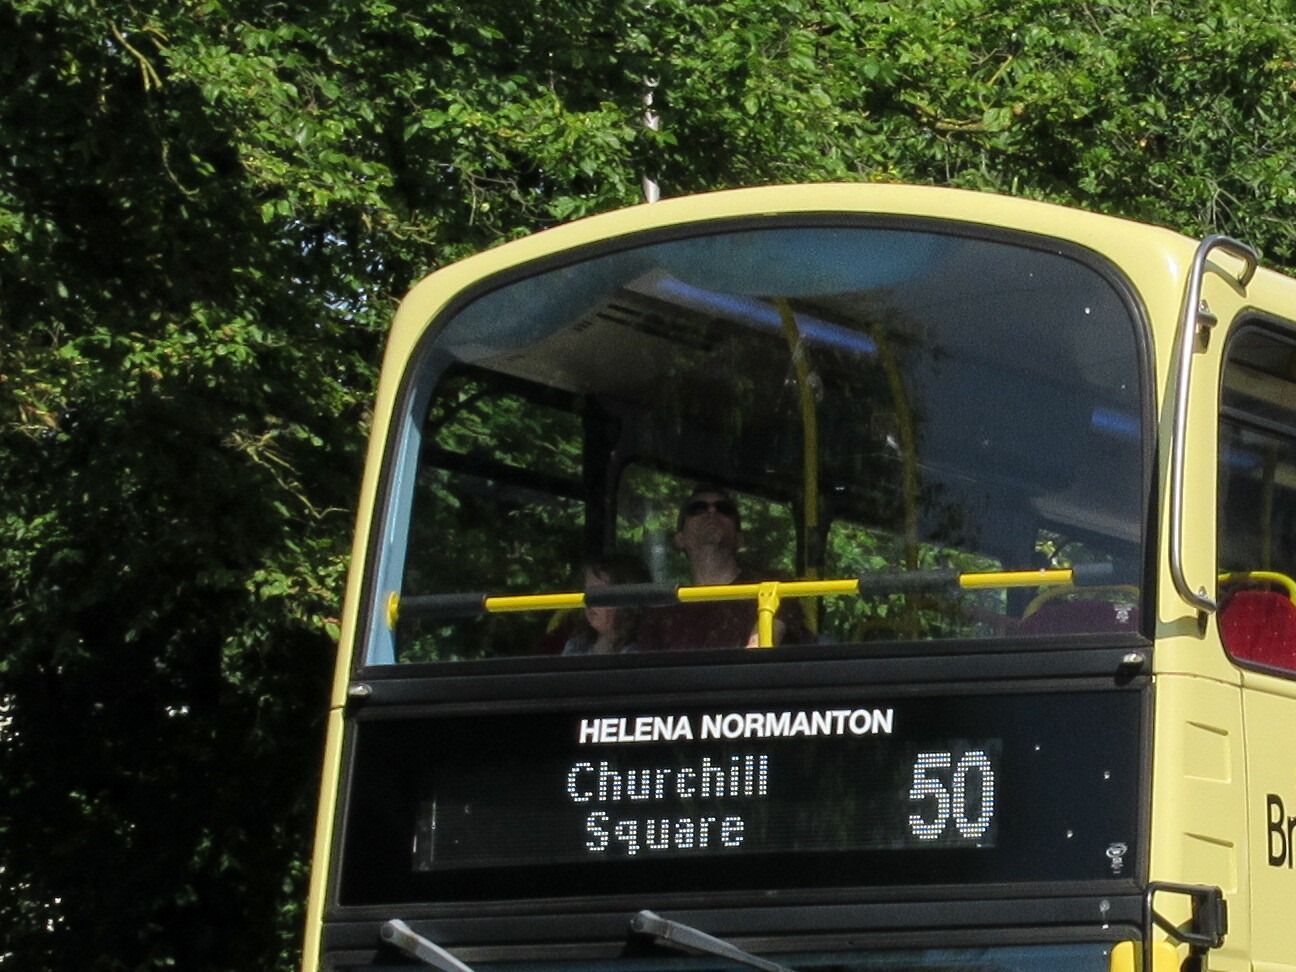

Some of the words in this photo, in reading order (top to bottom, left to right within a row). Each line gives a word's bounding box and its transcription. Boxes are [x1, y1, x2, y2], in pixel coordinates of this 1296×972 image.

[579, 715, 694, 743] HELENA
[701, 708, 894, 739] NORMANTON
[567, 755, 768, 802] Churchill
[908, 749, 996, 840] 50
[586, 811, 744, 855] Square
